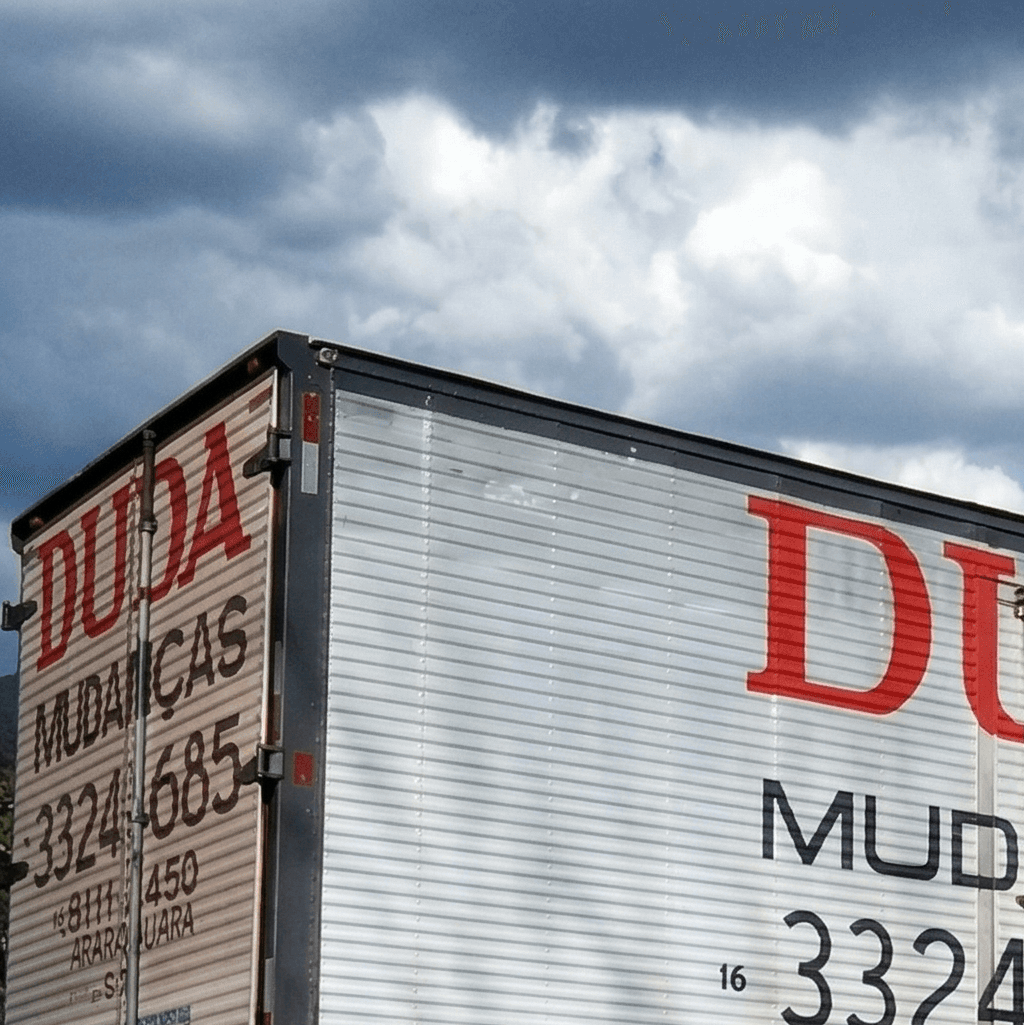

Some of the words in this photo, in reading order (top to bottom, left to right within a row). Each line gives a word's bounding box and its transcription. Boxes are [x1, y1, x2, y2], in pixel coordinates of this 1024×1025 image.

[37, 421, 252, 672] DUDA
[70, 902, 195, 970] ARARAUARA
[719, 963, 747, 992] 16
